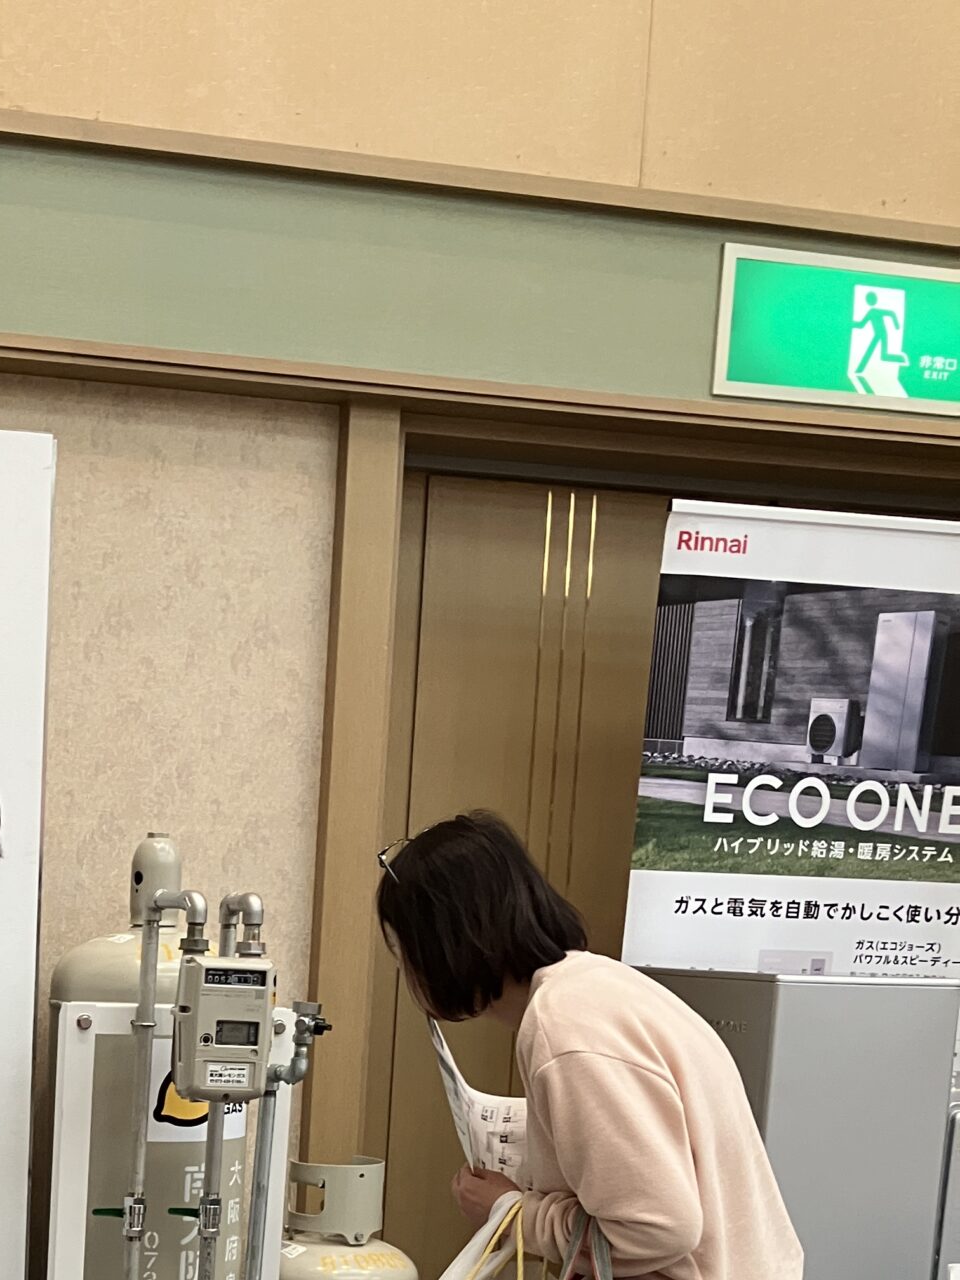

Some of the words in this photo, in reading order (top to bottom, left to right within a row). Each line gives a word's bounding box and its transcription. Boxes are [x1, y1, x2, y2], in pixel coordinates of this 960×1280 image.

[919, 355, 957, 371] 非常口
[923, 370, 950, 381] EXIT
[676, 530, 748, 555] Rinnai
[702, 772, 831, 829] ECO
[846, 780, 960, 834] ONE
